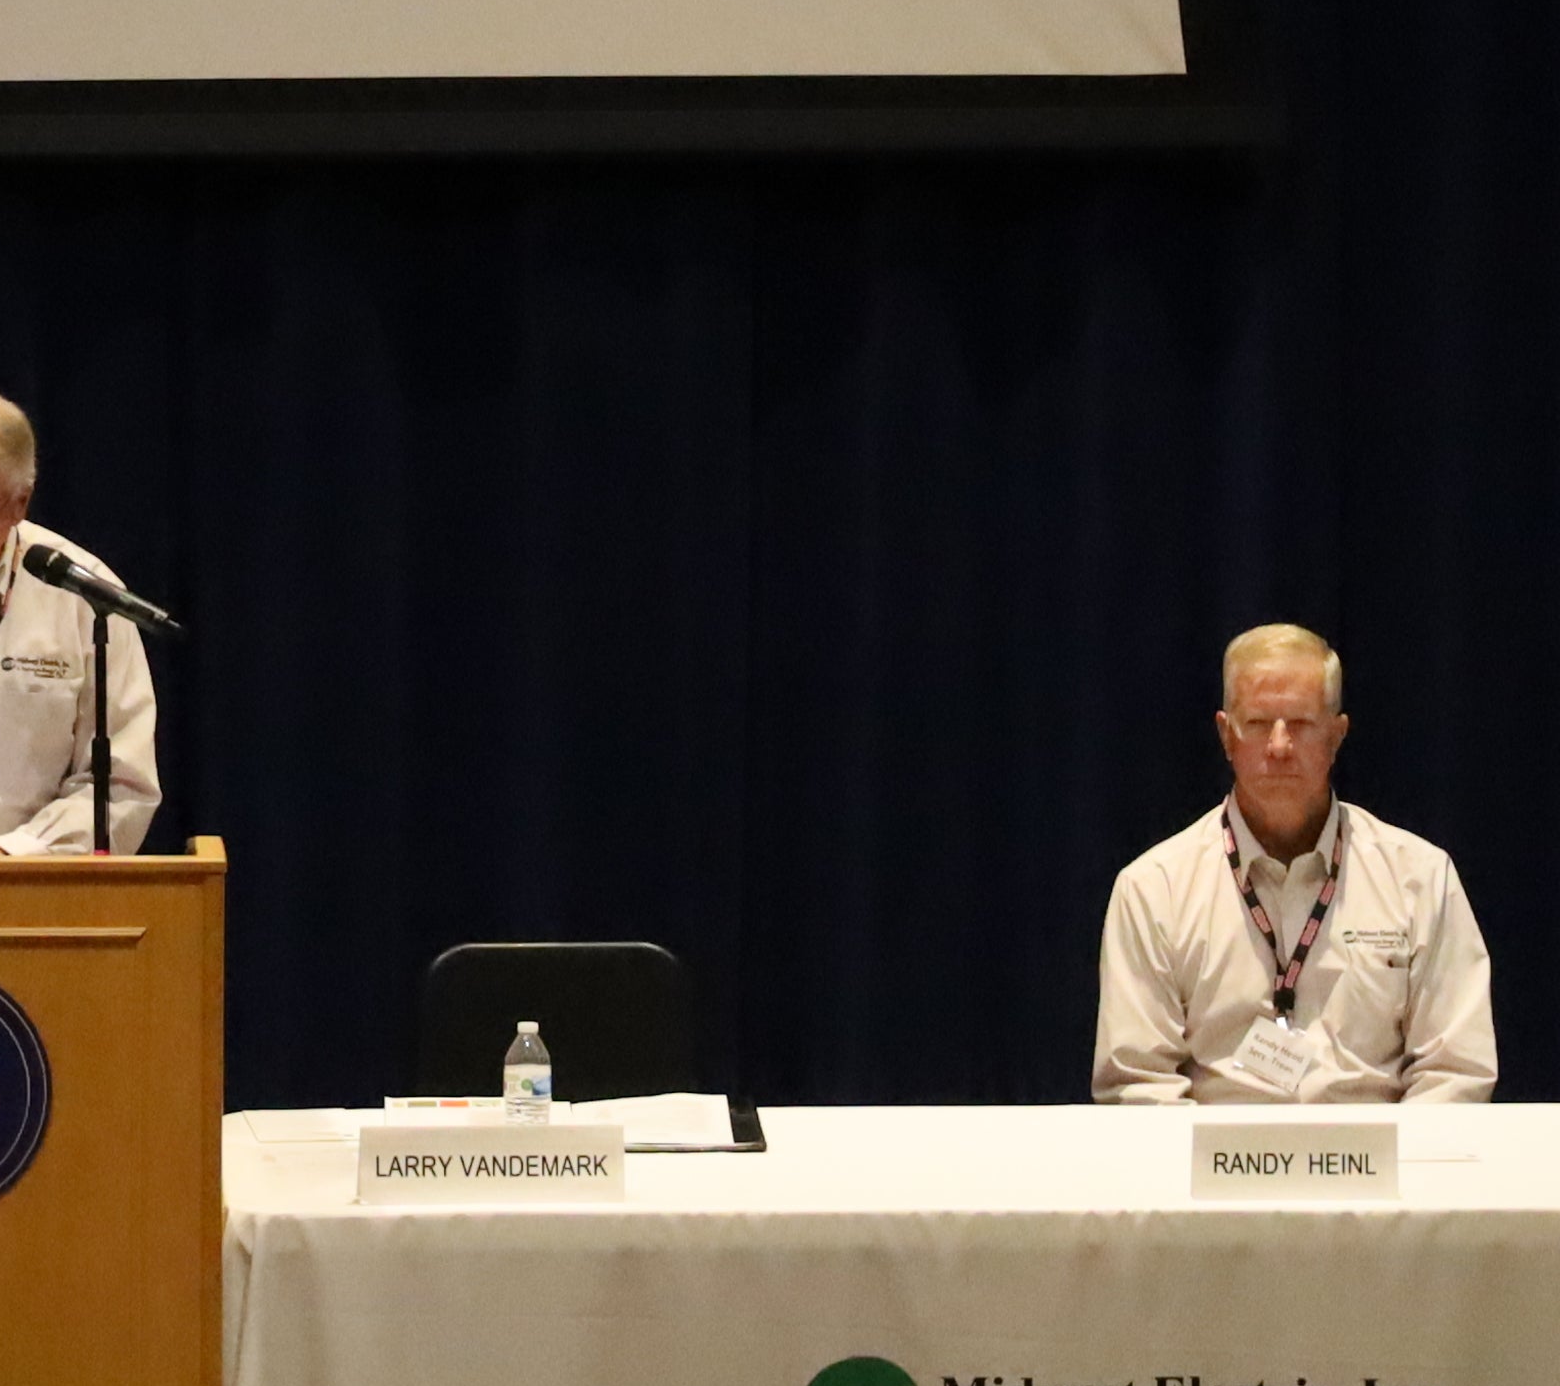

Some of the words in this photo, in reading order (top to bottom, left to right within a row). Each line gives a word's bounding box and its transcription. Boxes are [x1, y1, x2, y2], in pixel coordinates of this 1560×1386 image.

[375, 1154, 453, 1178] LARRY
[459, 1154, 608, 1178] VANDEMARK
[1213, 1151, 1294, 1175] RANDY
[1308, 1152, 1376, 1175] HEINL
